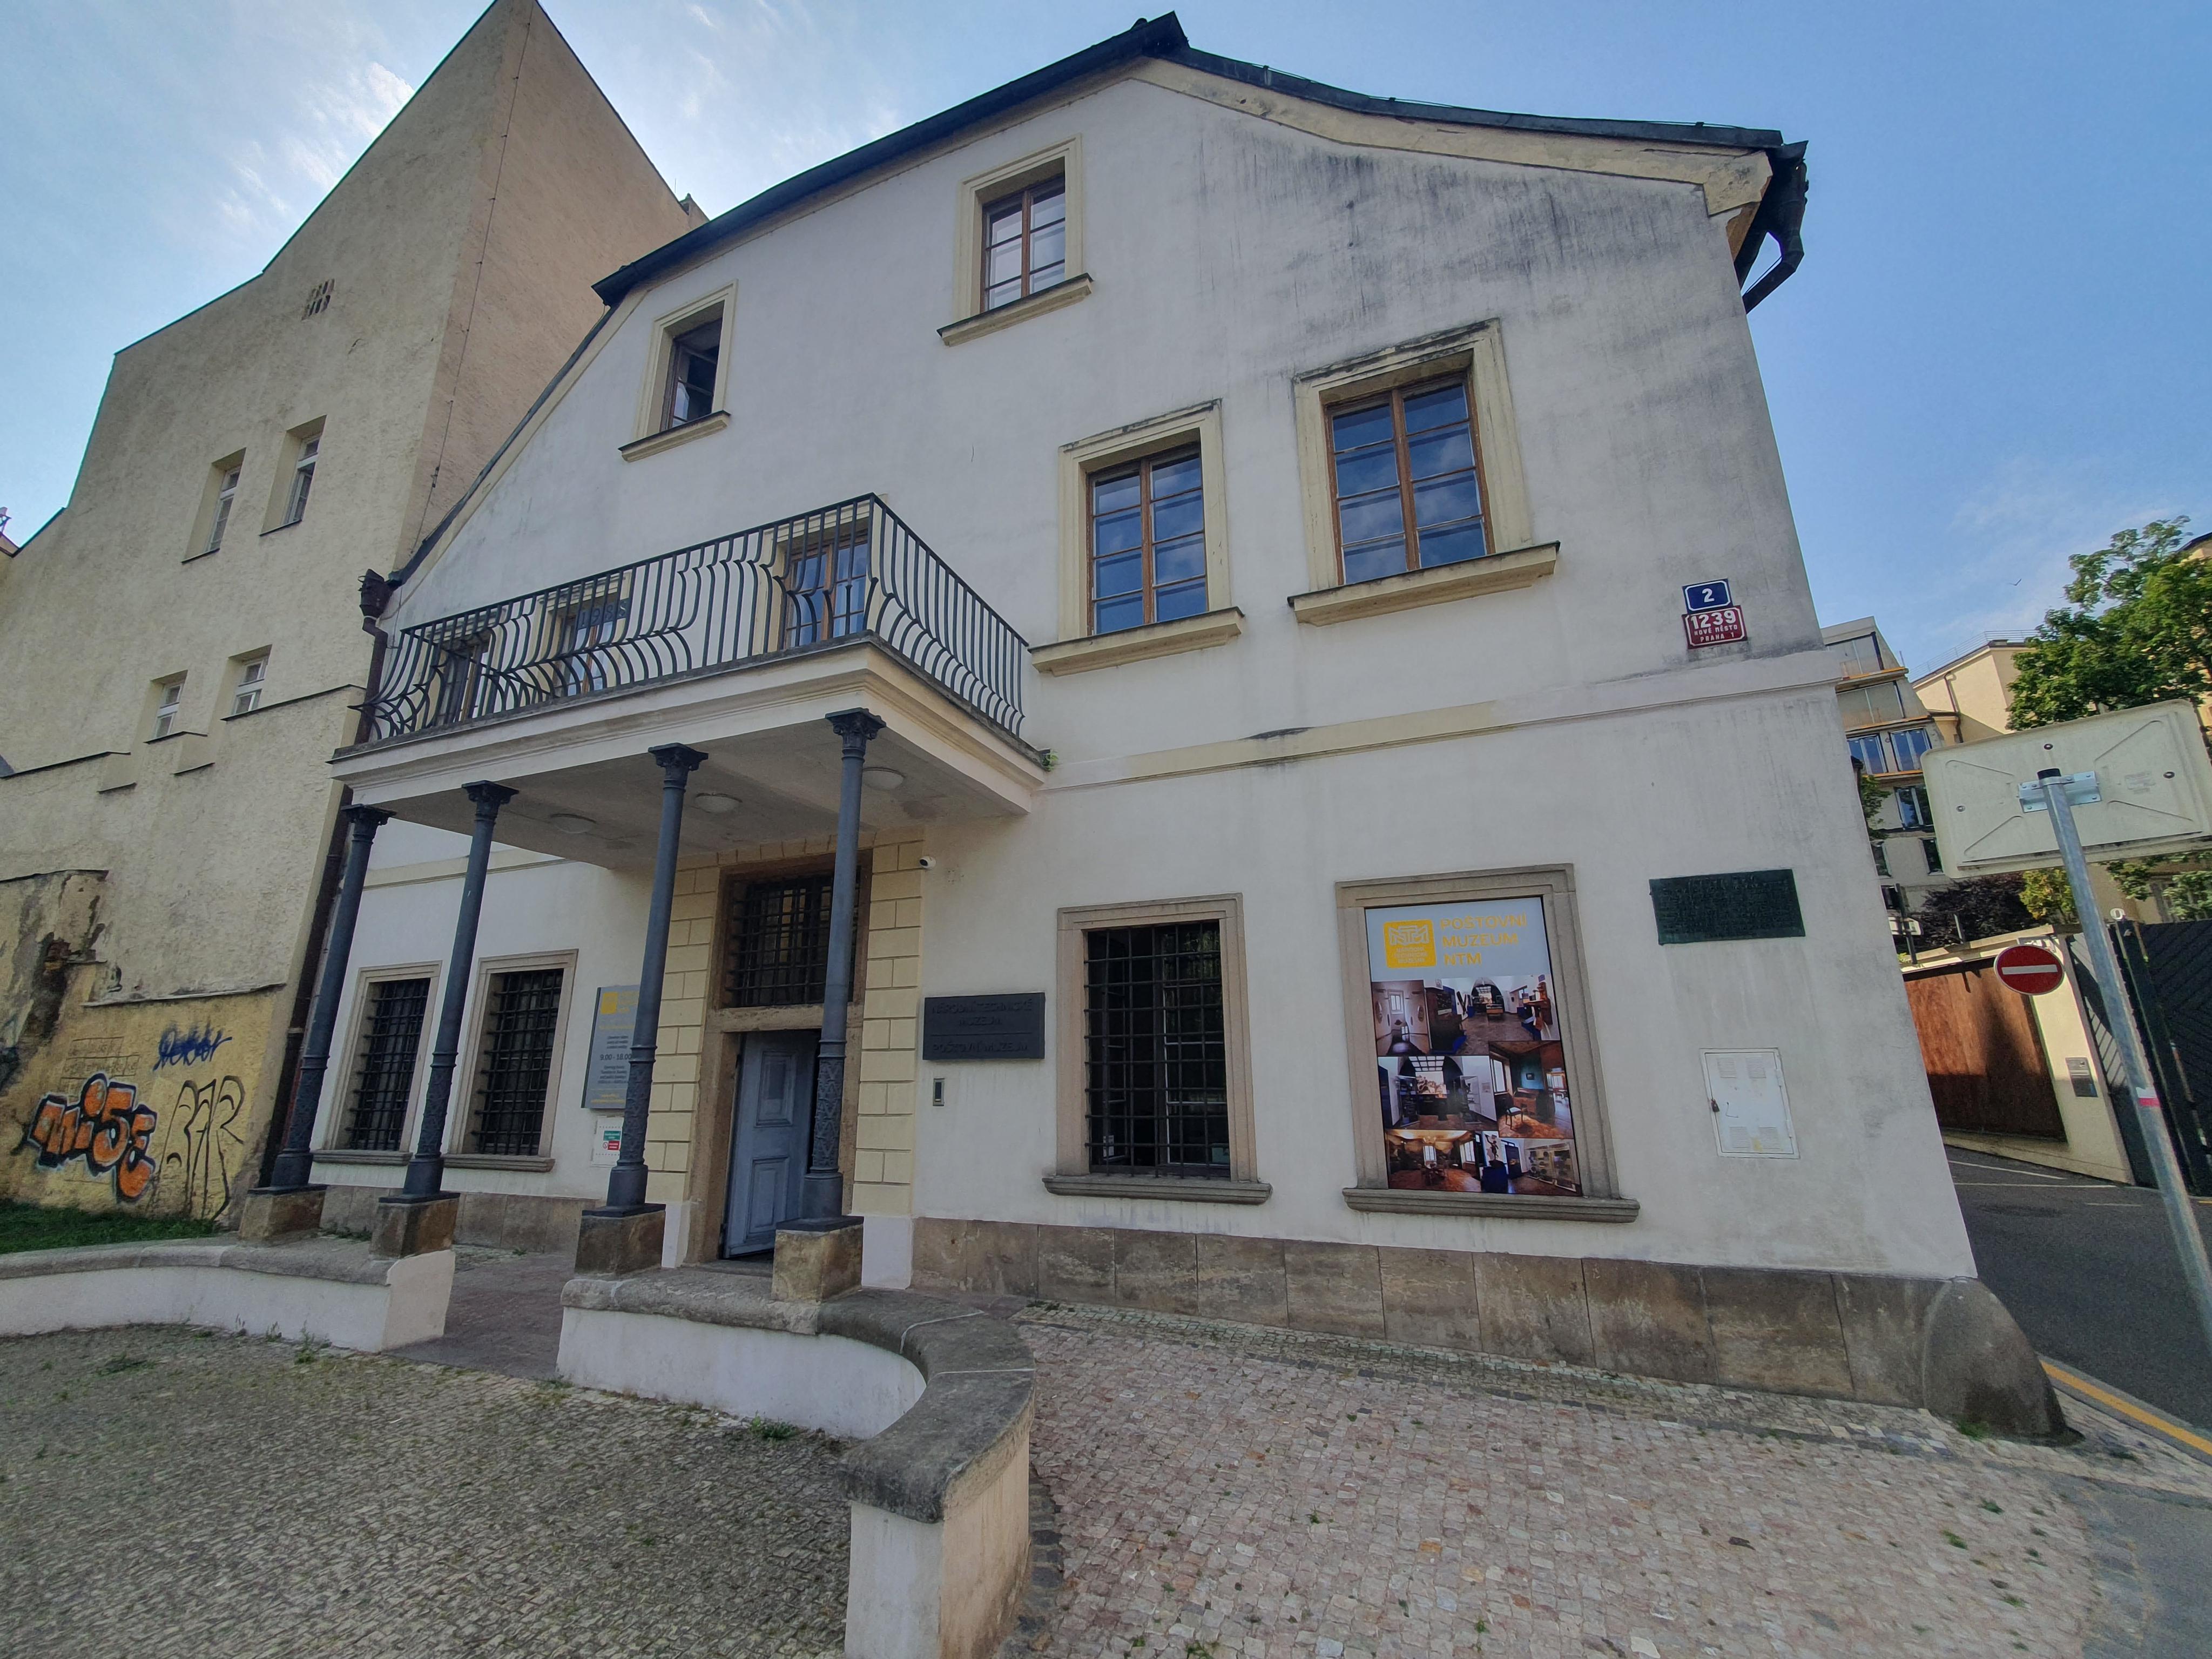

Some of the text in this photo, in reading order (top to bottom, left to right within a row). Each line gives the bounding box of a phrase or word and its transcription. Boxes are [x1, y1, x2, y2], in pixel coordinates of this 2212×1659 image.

[1702, 588, 1715, 603] 2
[1691, 610, 1736, 629] 1239
[1694, 626, 1712, 636] NOVÉ
[1700, 633, 1725, 642] PRAHA
[1440, 912, 1528, 931] POŠTOVNÍ
[1442, 933, 1519, 948] MUZEUM
[1444, 952, 1482, 966] NTM
